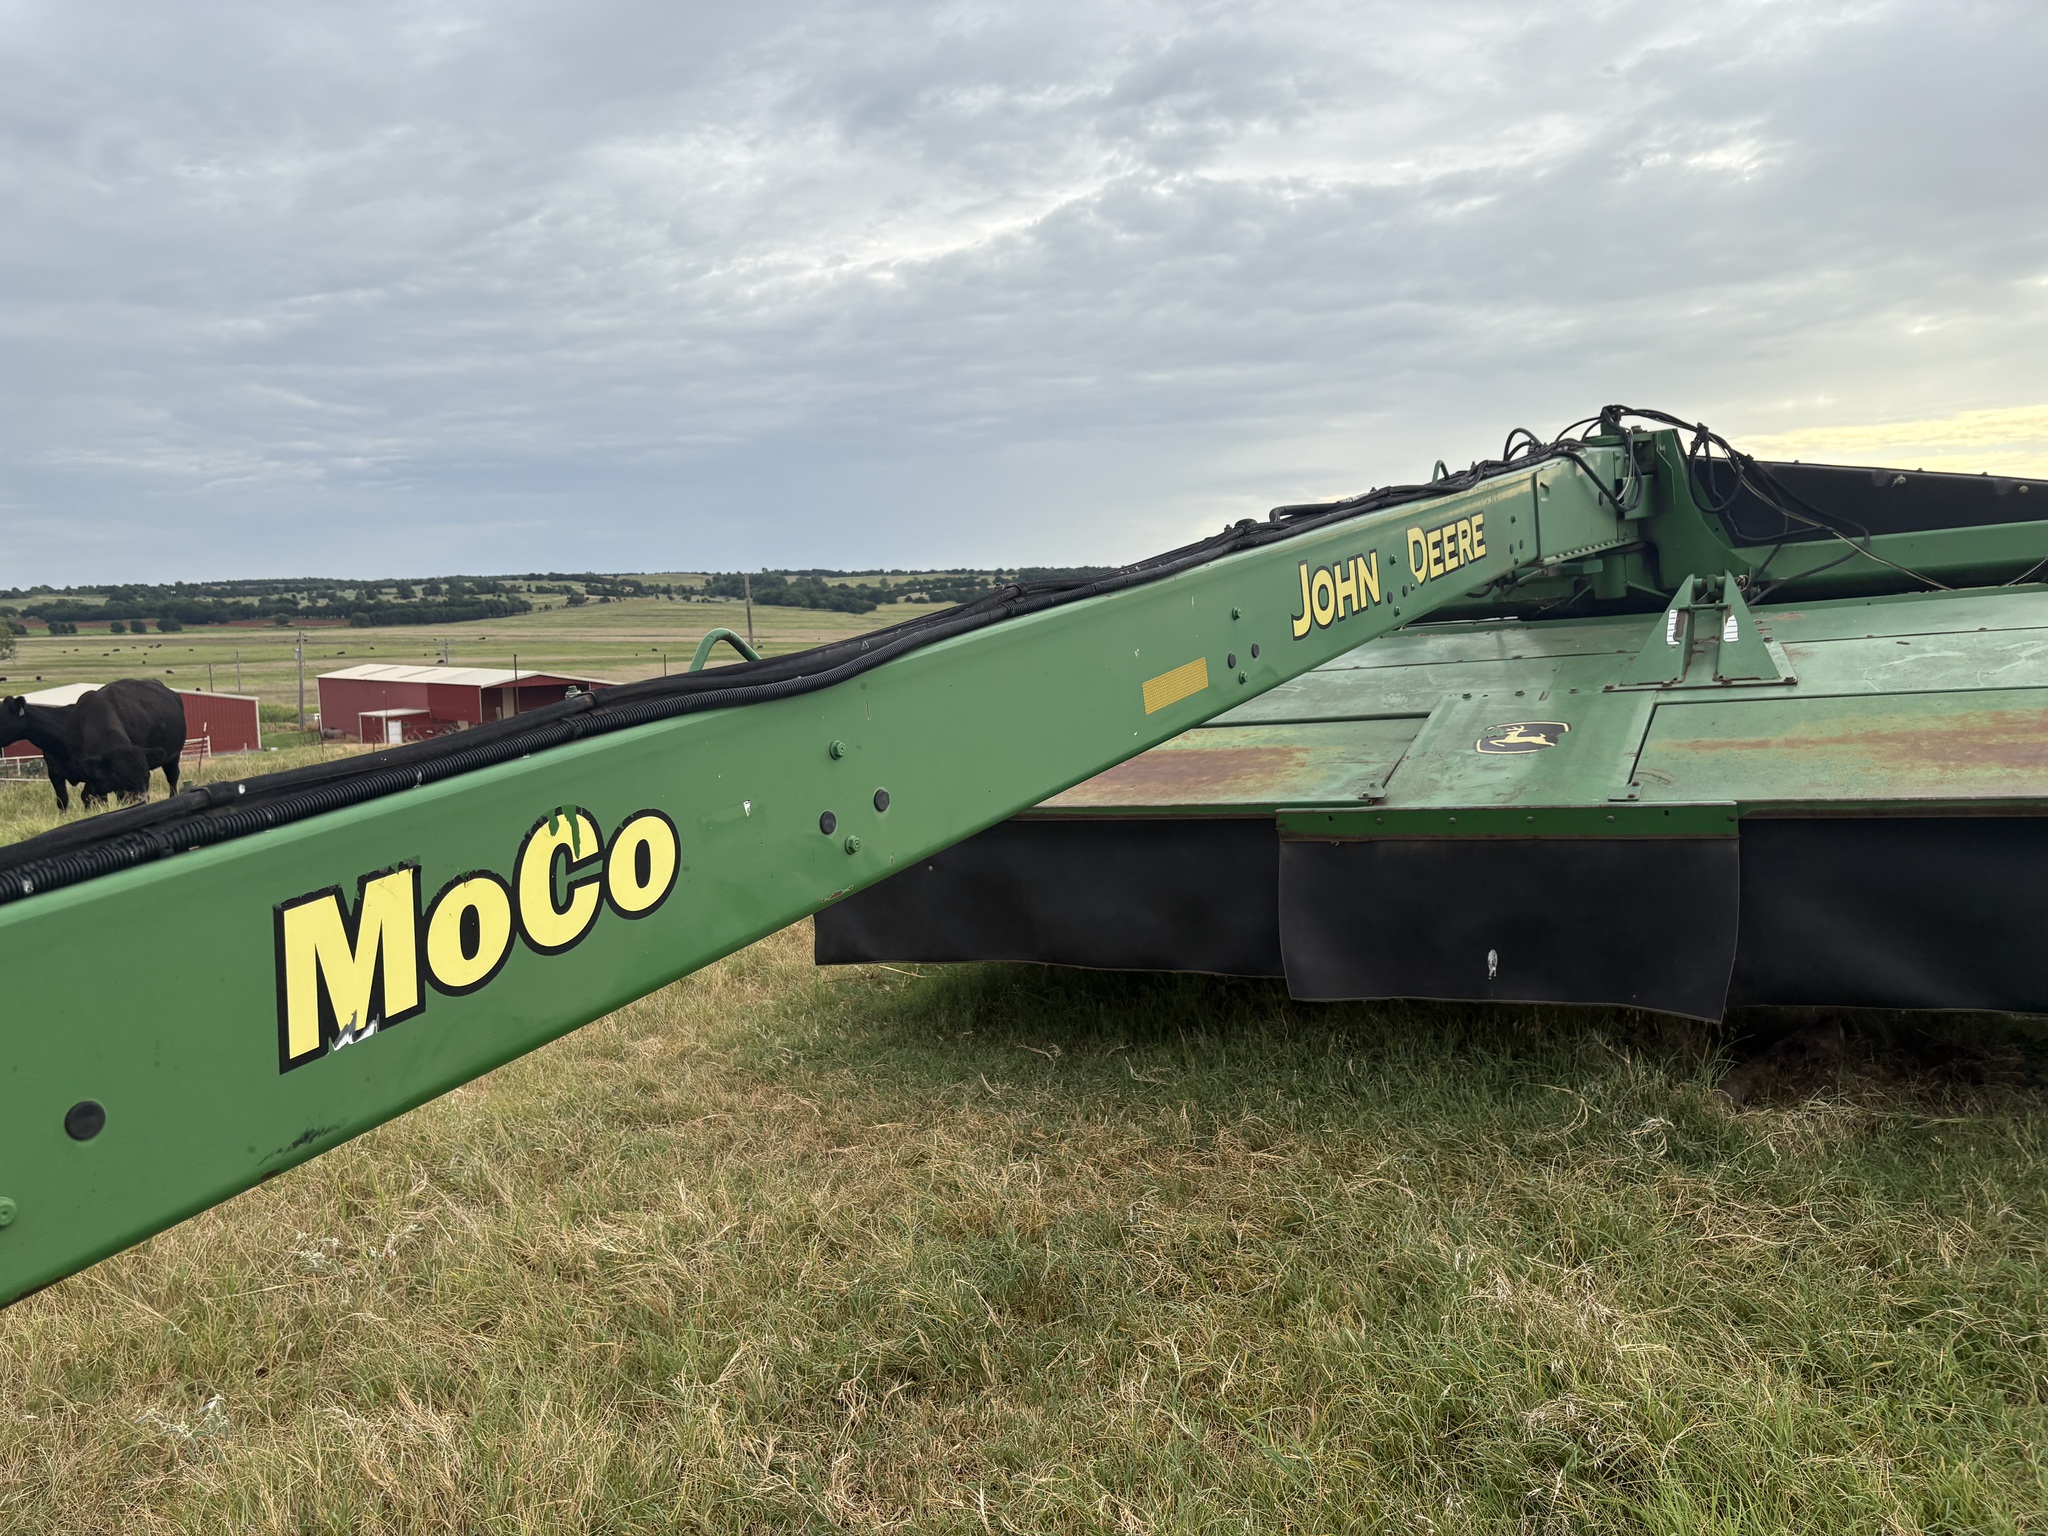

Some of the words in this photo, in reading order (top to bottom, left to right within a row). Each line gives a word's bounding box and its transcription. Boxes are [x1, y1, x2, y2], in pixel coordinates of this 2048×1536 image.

[1291, 549, 1381, 640] JOHN
[1406, 513, 1486, 585] DEERE
[274, 806, 680, 1074] MoCo
